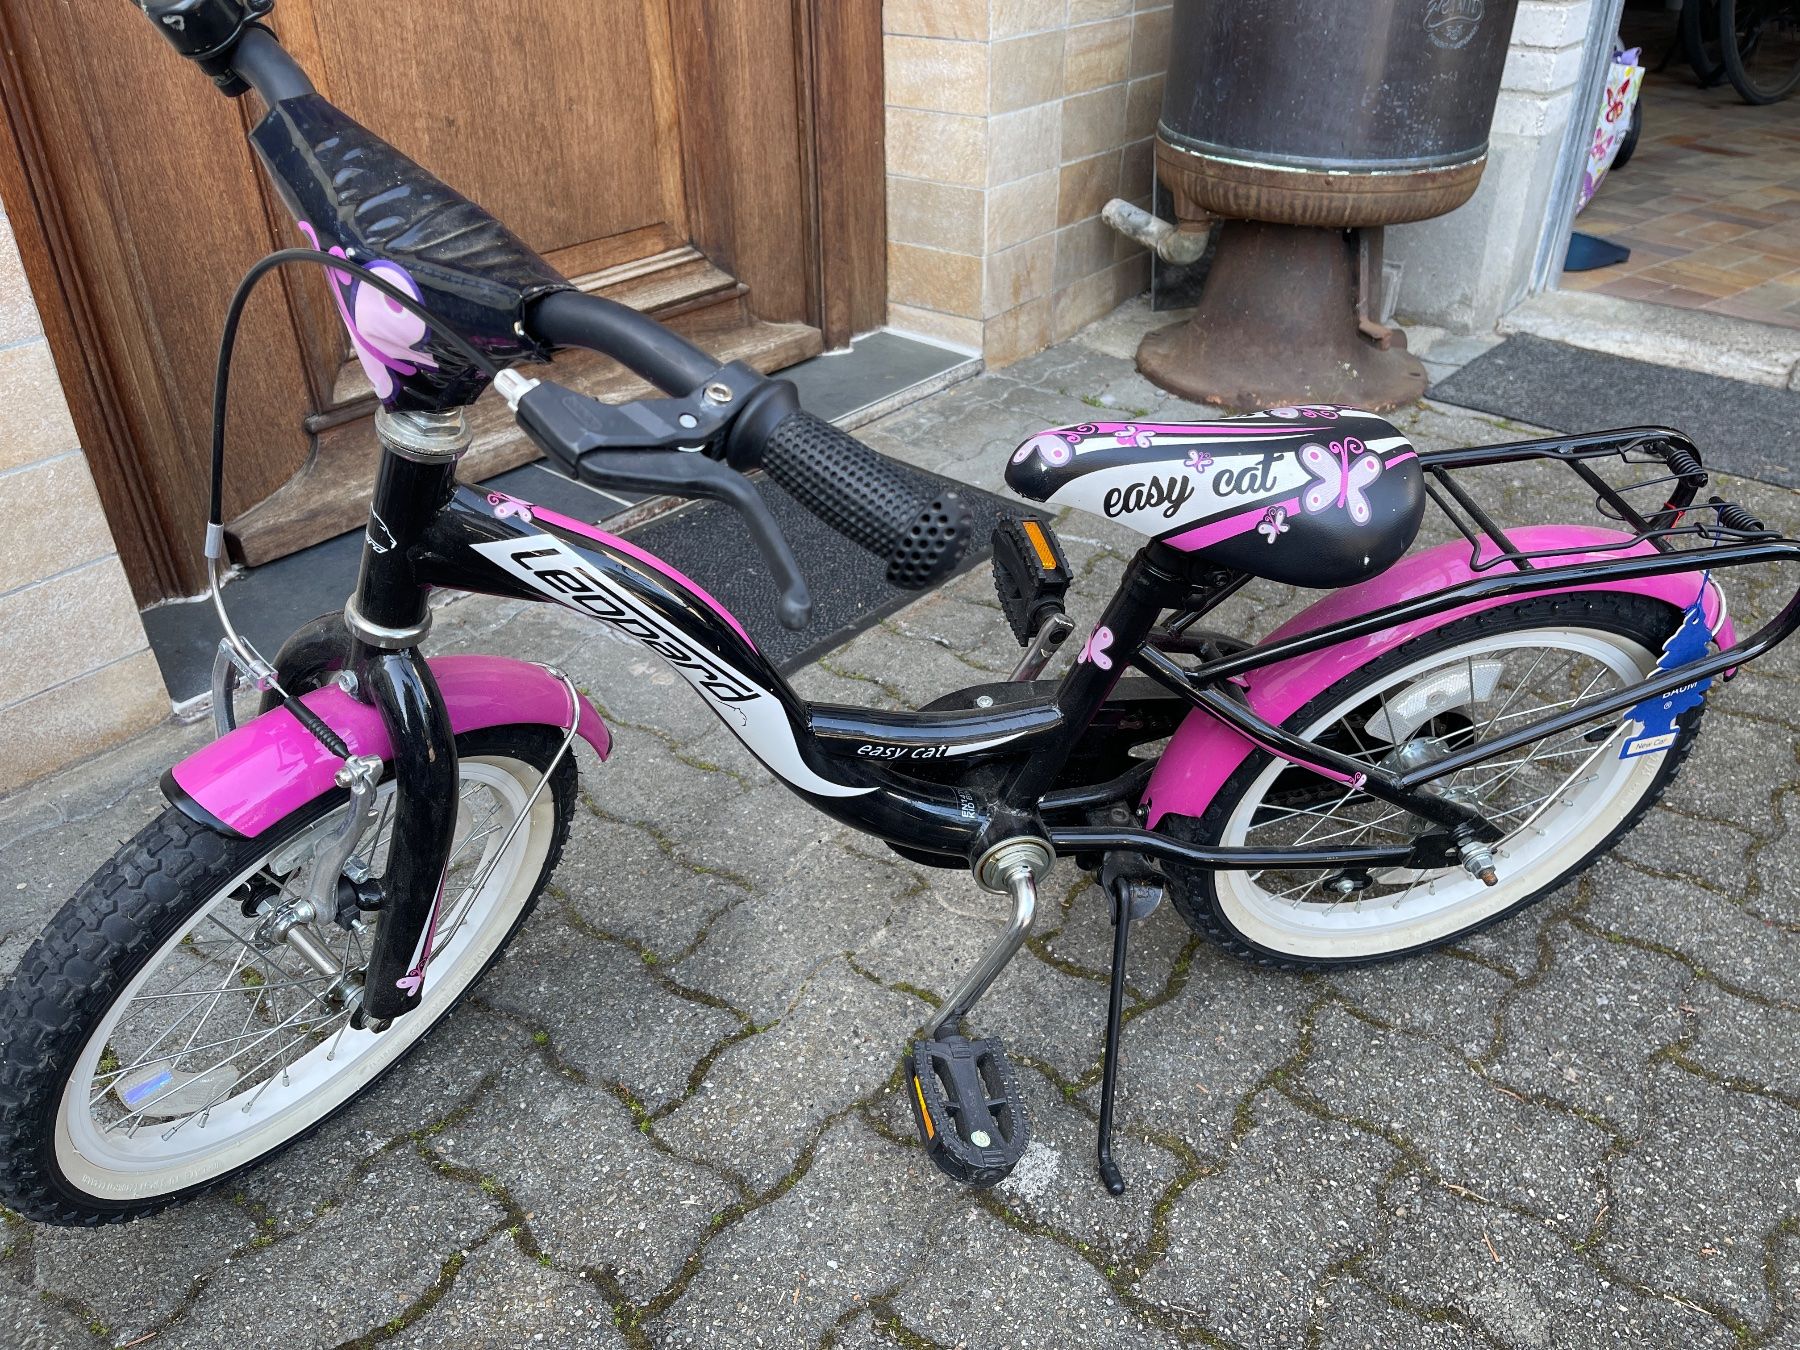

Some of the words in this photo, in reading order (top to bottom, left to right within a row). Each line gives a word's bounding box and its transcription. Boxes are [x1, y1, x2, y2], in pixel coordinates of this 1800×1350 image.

[1103, 474, 1195, 519] easy
[1212, 453, 1285, 497] cat
[857, 744, 909, 760] easy
[911, 744, 947, 759] cat
[967, 802, 976, 819] KID
